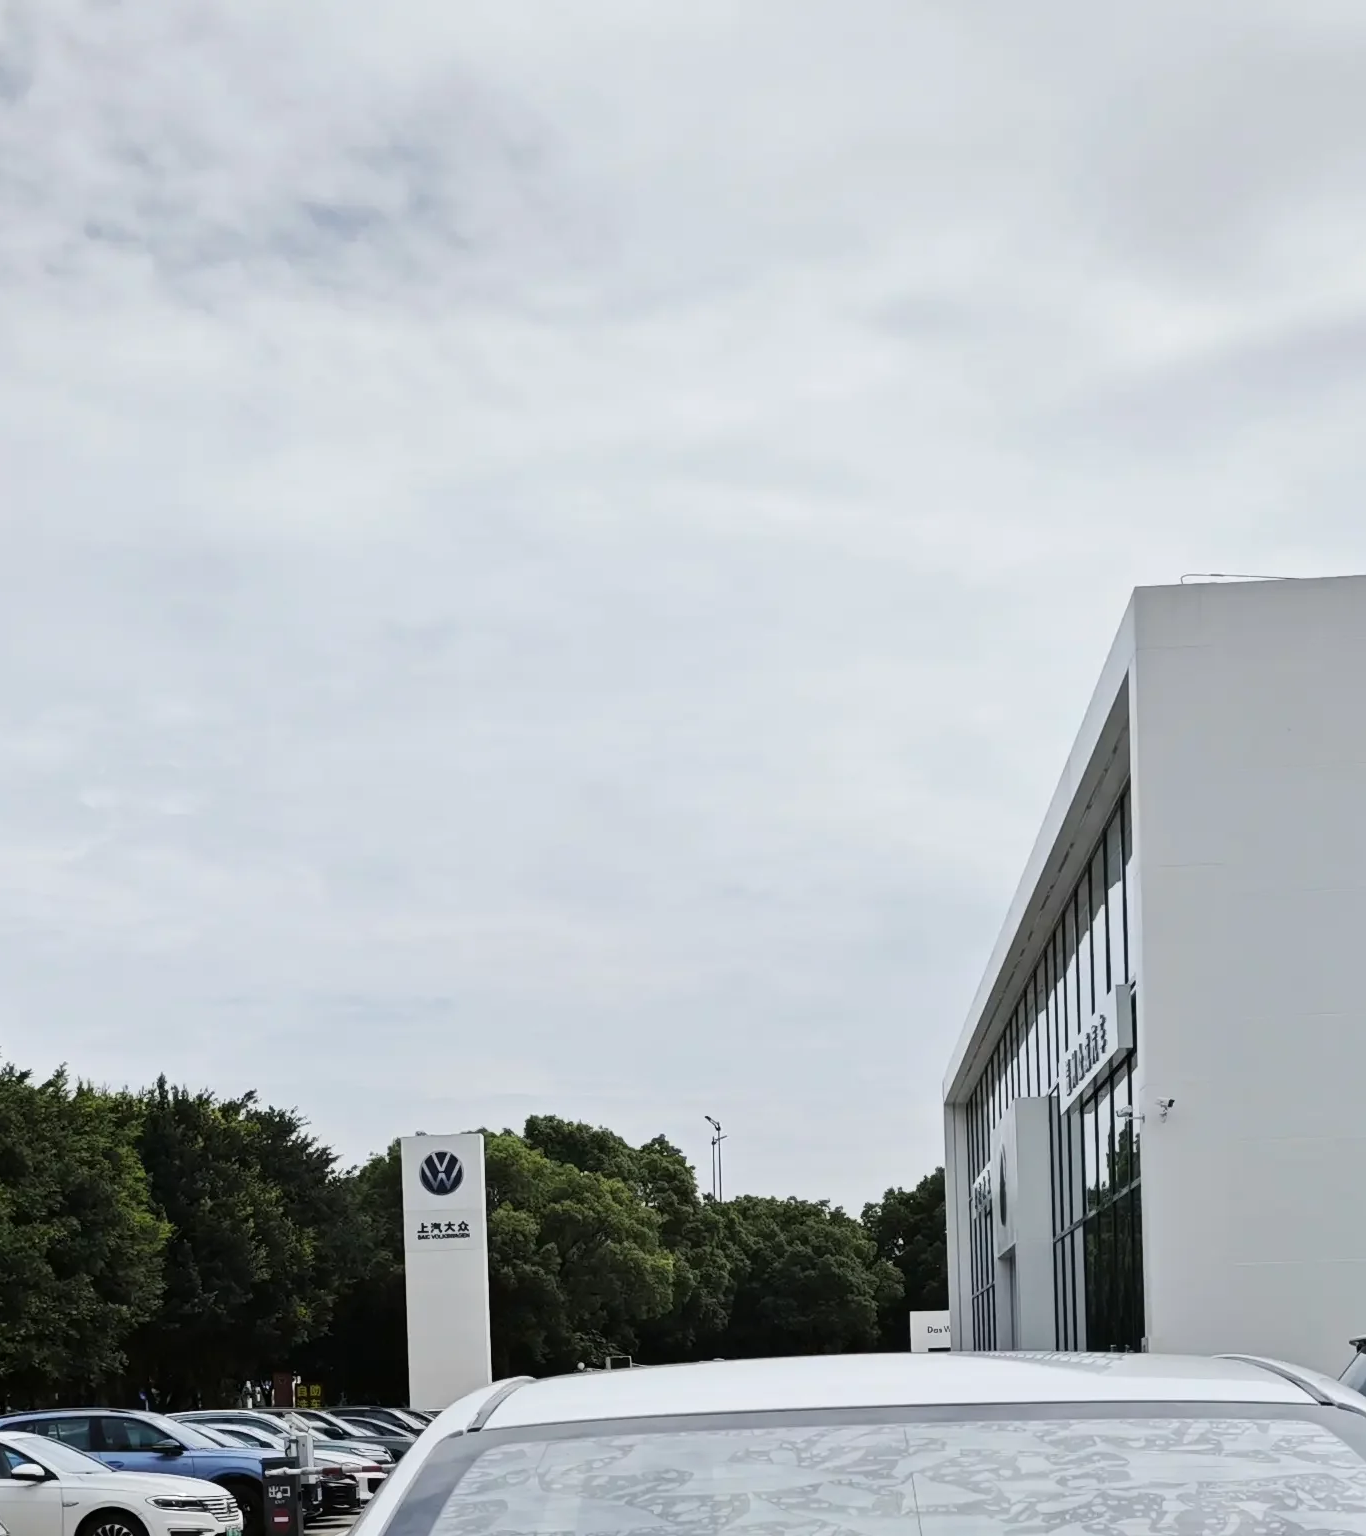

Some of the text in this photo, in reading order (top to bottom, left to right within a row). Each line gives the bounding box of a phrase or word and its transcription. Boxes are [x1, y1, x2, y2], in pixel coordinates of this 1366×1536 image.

[417, 1221, 470, 1234] 上汽大众
[296, 1384, 322, 1397] 自助
[268, 1485, 291, 1498] 出口
